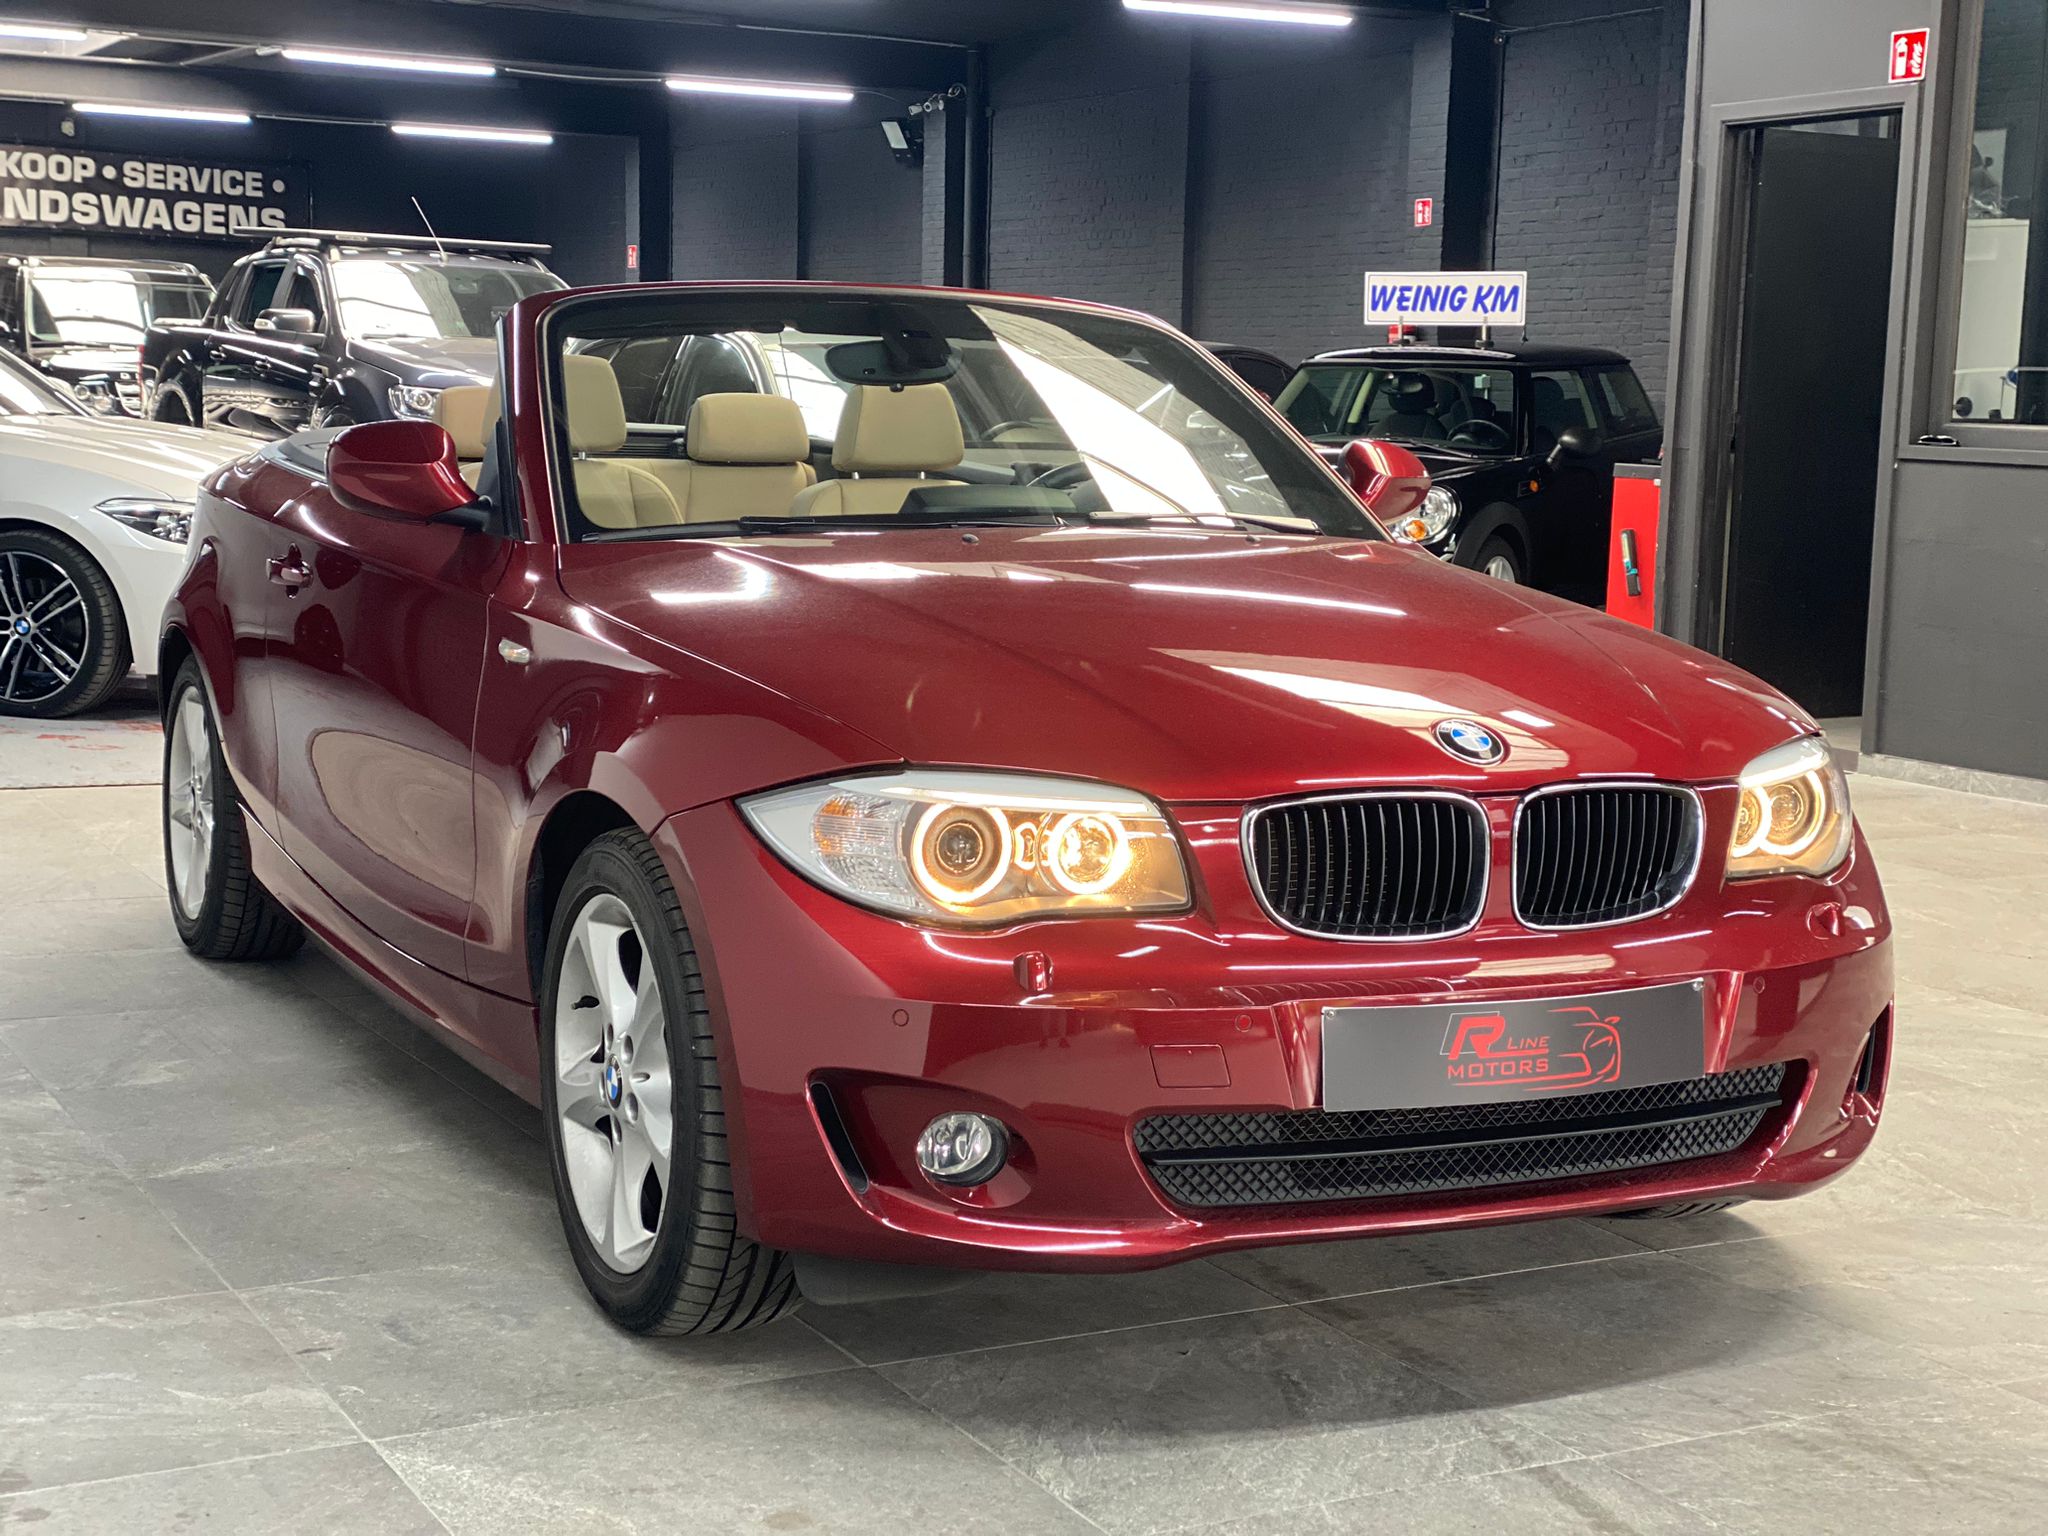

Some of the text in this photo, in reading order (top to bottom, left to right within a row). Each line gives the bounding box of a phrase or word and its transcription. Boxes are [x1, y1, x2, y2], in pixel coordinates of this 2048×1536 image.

[0, 150, 263, 198] KOOP SERVICE
[1371, 284, 1520, 314] WEINIG KM
[1447, 1015, 1551, 1060] R LINE
[1447, 1058, 1549, 1080] MOTORS
